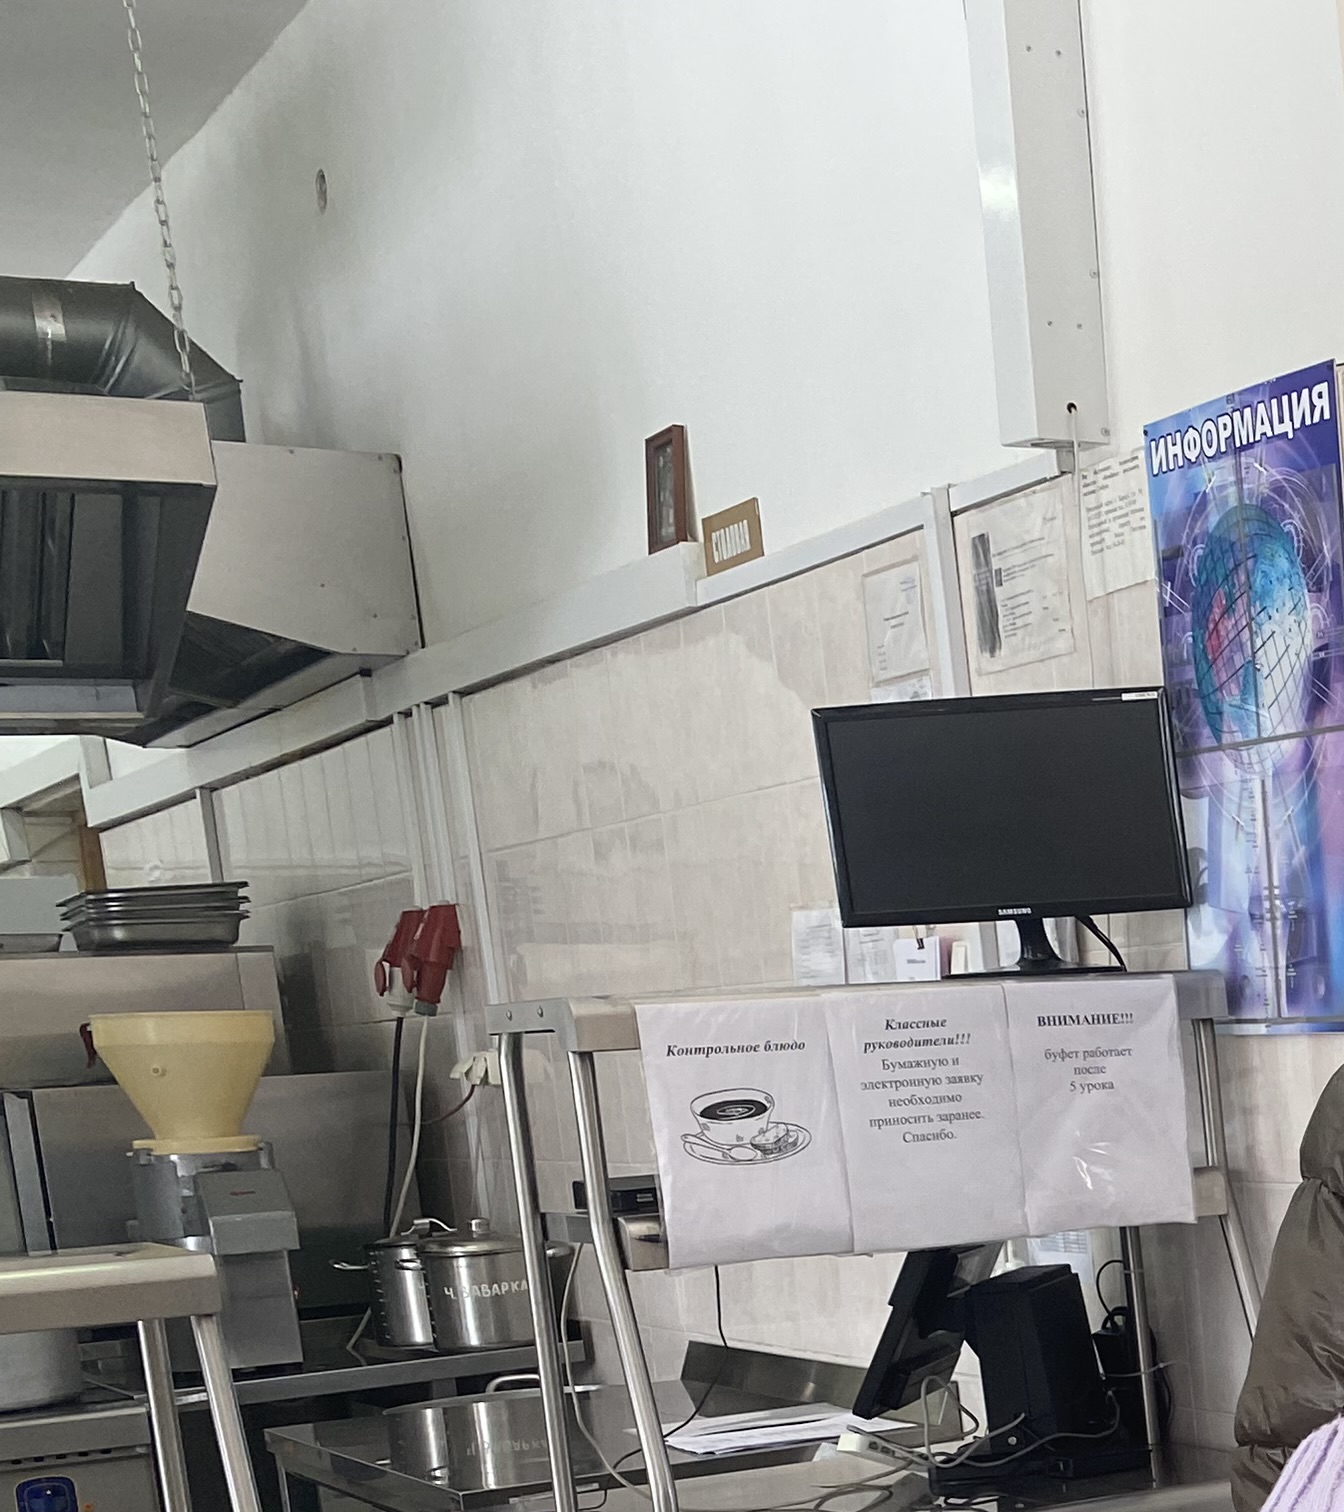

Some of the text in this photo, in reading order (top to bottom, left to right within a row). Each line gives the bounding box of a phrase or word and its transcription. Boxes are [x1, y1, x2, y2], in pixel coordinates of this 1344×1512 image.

[1150, 382, 1330, 476] ИНФОРМАЦИЯ
[998, 907, 1032, 916] SAMSUNG
[884, 1016, 947, 1032] Классные
[1036, 1011, 1134, 1028] ВНИМАНИЕ!!!
[666, 1038, 806, 1058] Контрольное блюдо
[864, 1032, 971, 1054] руководители!!!
[1044, 1046, 1132, 1064] буфет работает
[881, 1055, 959, 1073] Бумажную и
[1073, 1063, 1106, 1076] после
[860, 1072, 984, 1092] электронную заявку
[1070, 1080, 1114, 1095] 5 урока
[888, 1091, 962, 1108] необходимо
[869, 1109, 984, 1130] приносить заранее.
[902, 1127, 956, 1144] Спасибо.
